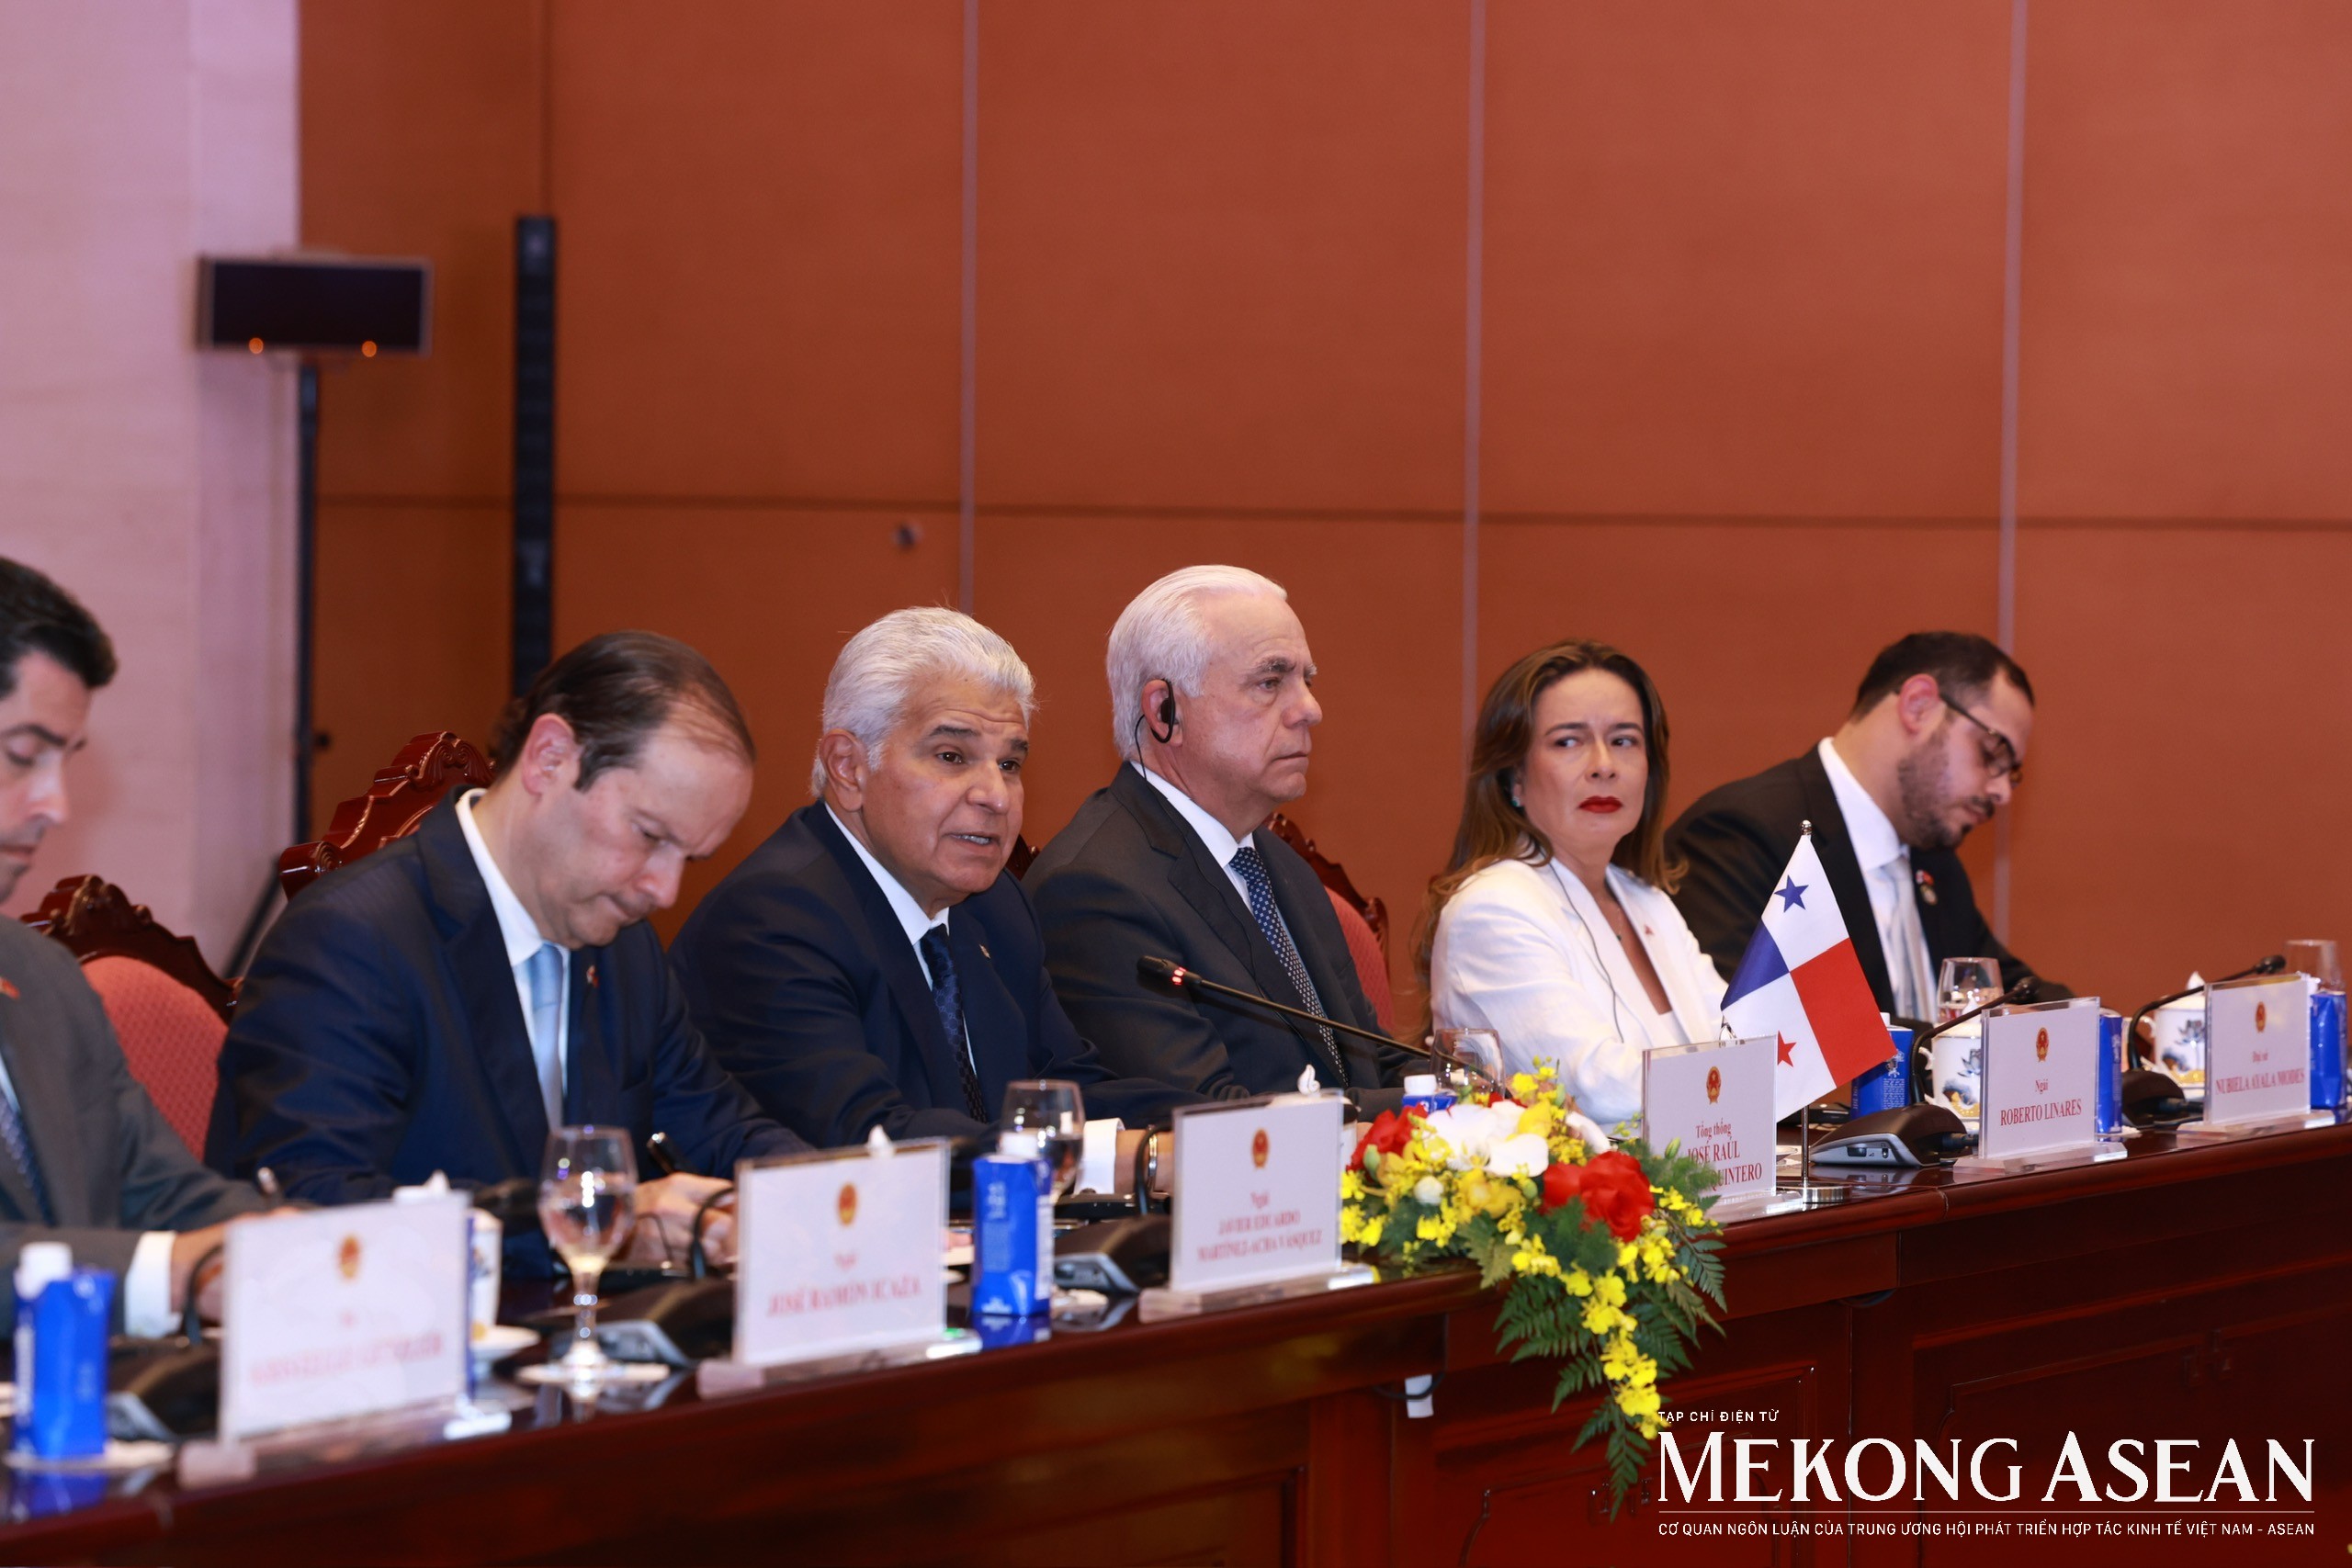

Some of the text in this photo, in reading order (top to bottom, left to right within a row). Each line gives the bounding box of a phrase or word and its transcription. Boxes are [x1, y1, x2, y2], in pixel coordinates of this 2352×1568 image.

[2000, 1099, 2082, 1126] ROBERTO LINARES
[1688, 1136, 1740, 1165] JOSÉ RAÚL
